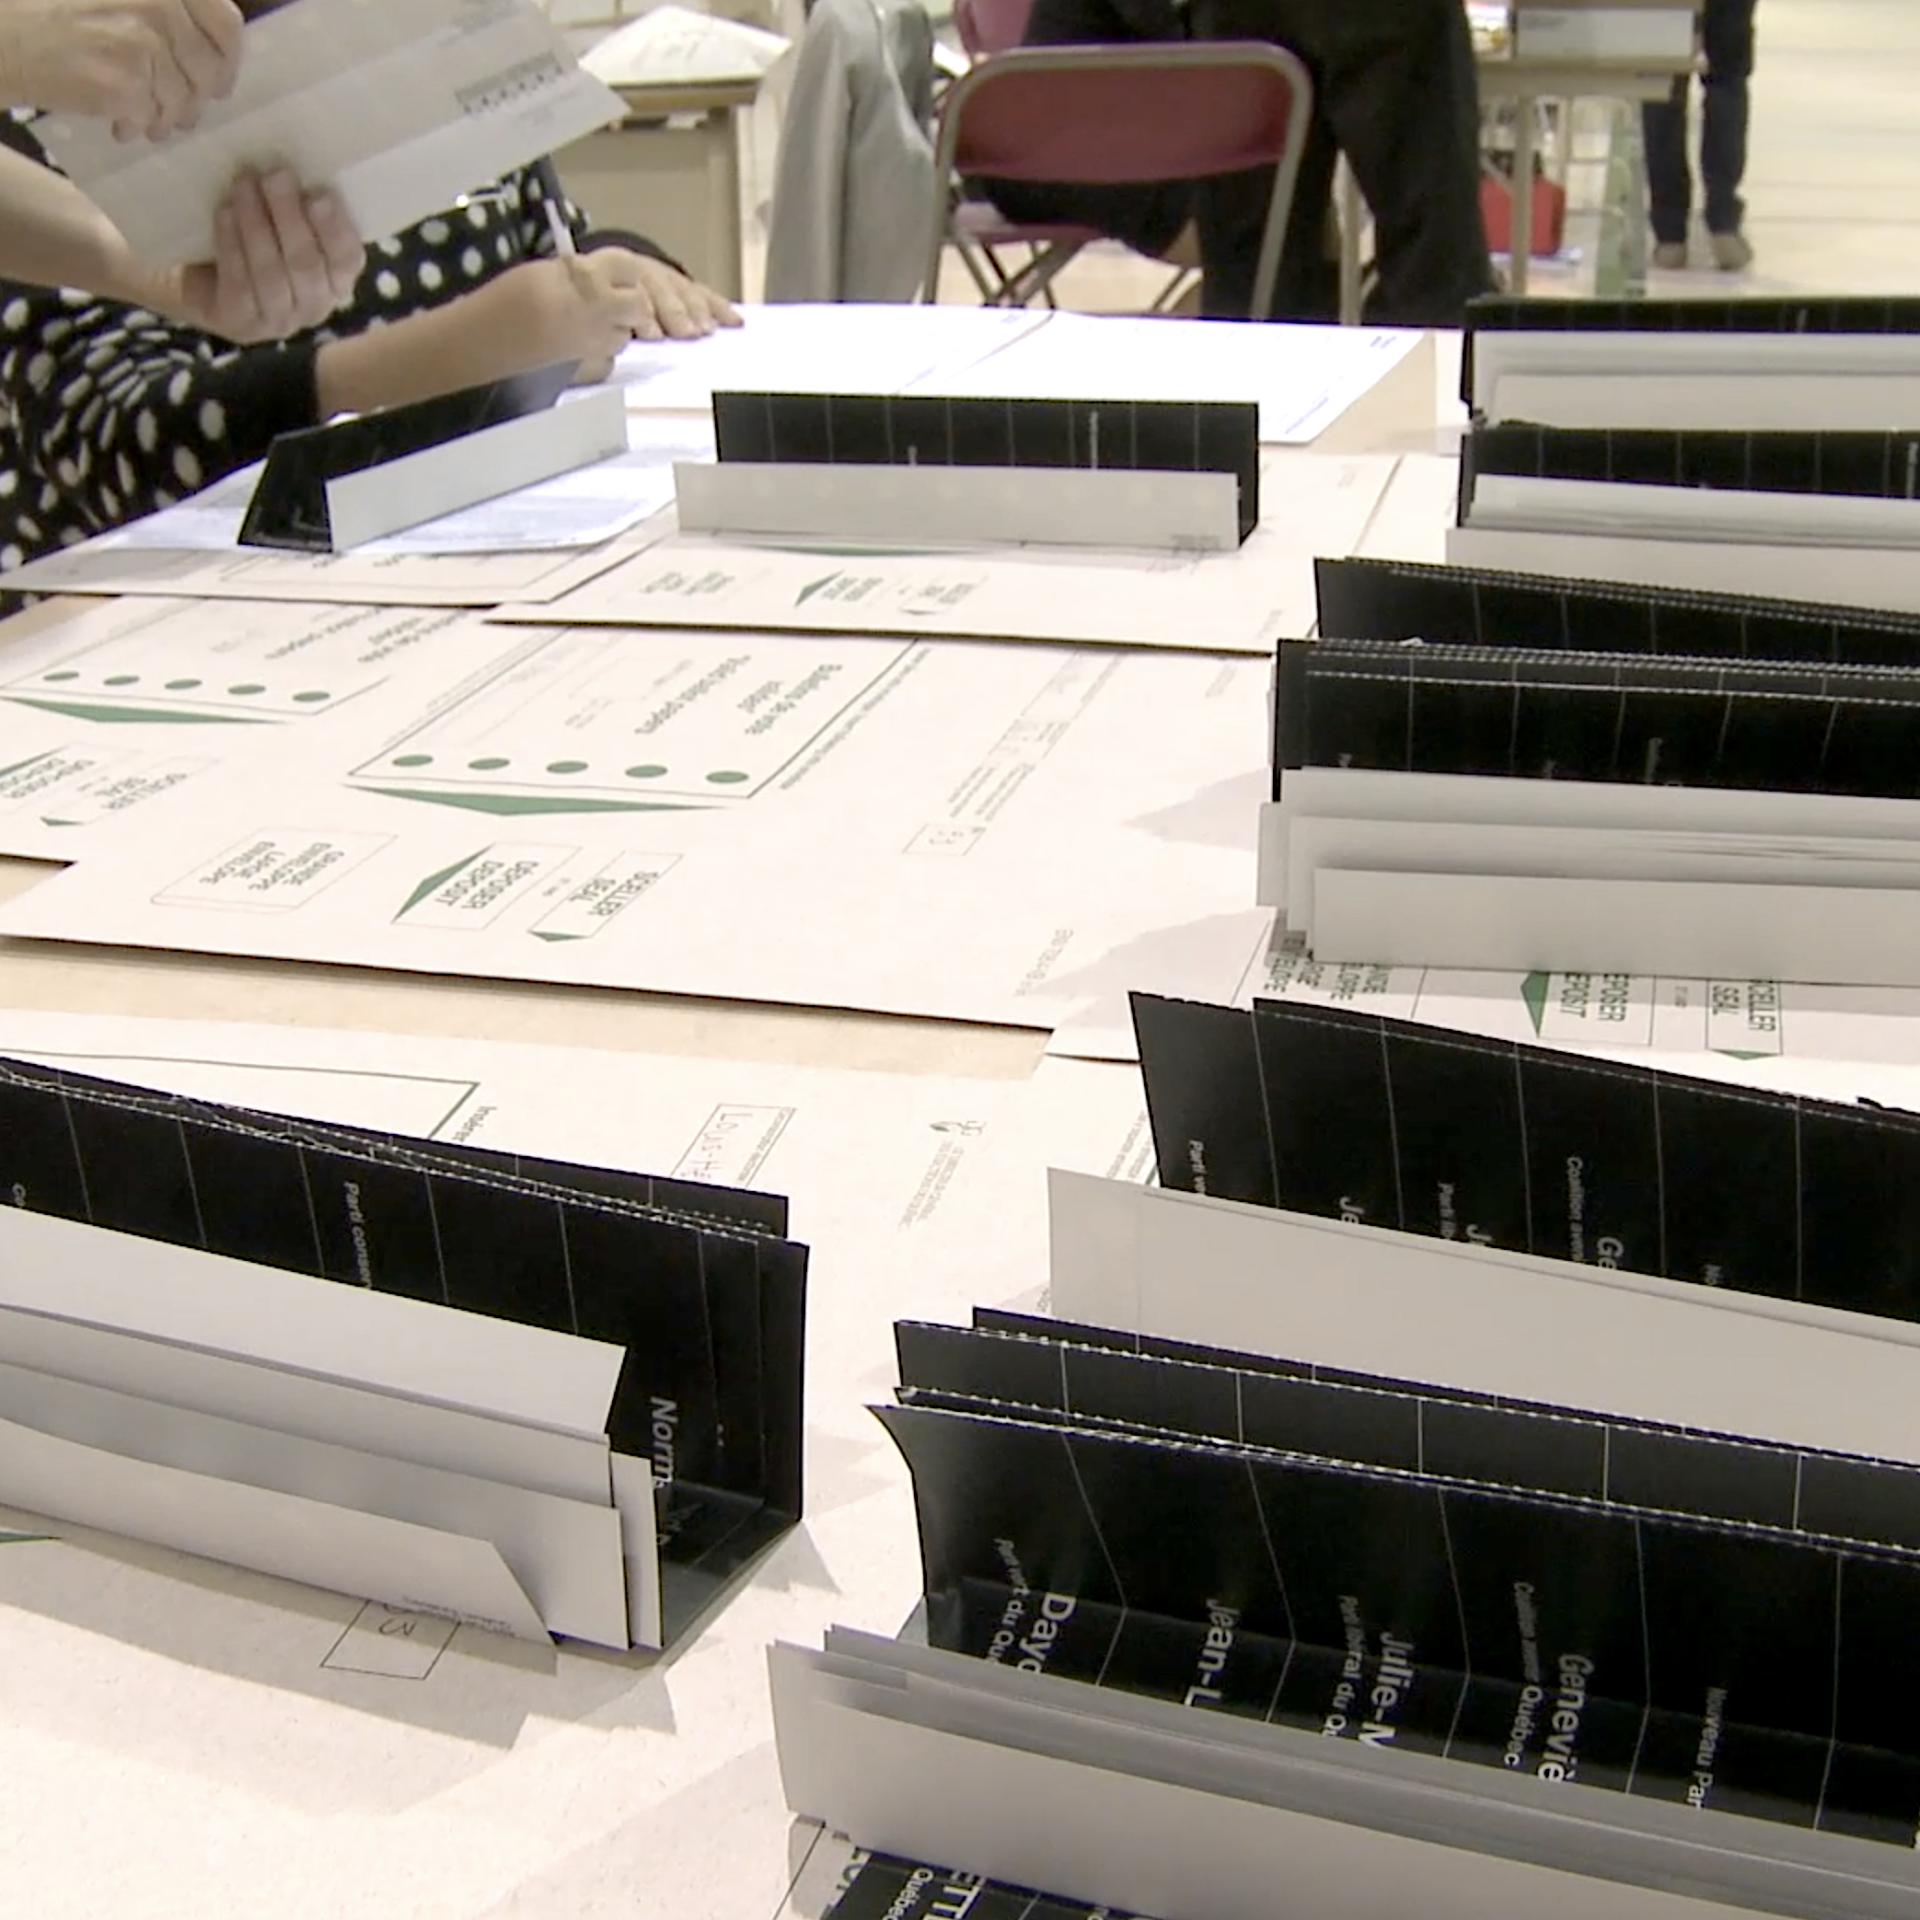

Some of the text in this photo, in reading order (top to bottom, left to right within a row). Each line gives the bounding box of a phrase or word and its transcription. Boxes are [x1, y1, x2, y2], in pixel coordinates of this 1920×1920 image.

[1711, 984, 1740, 1016] SEAL
[343, 1180, 363, 1224] Parti
[1002, 1599, 1025, 1627] du
[1332, 1682, 1356, 1711] du
[1503, 1684, 1543, 1767] Québec
[1696, 1686, 1729, 1767] Nouveau
